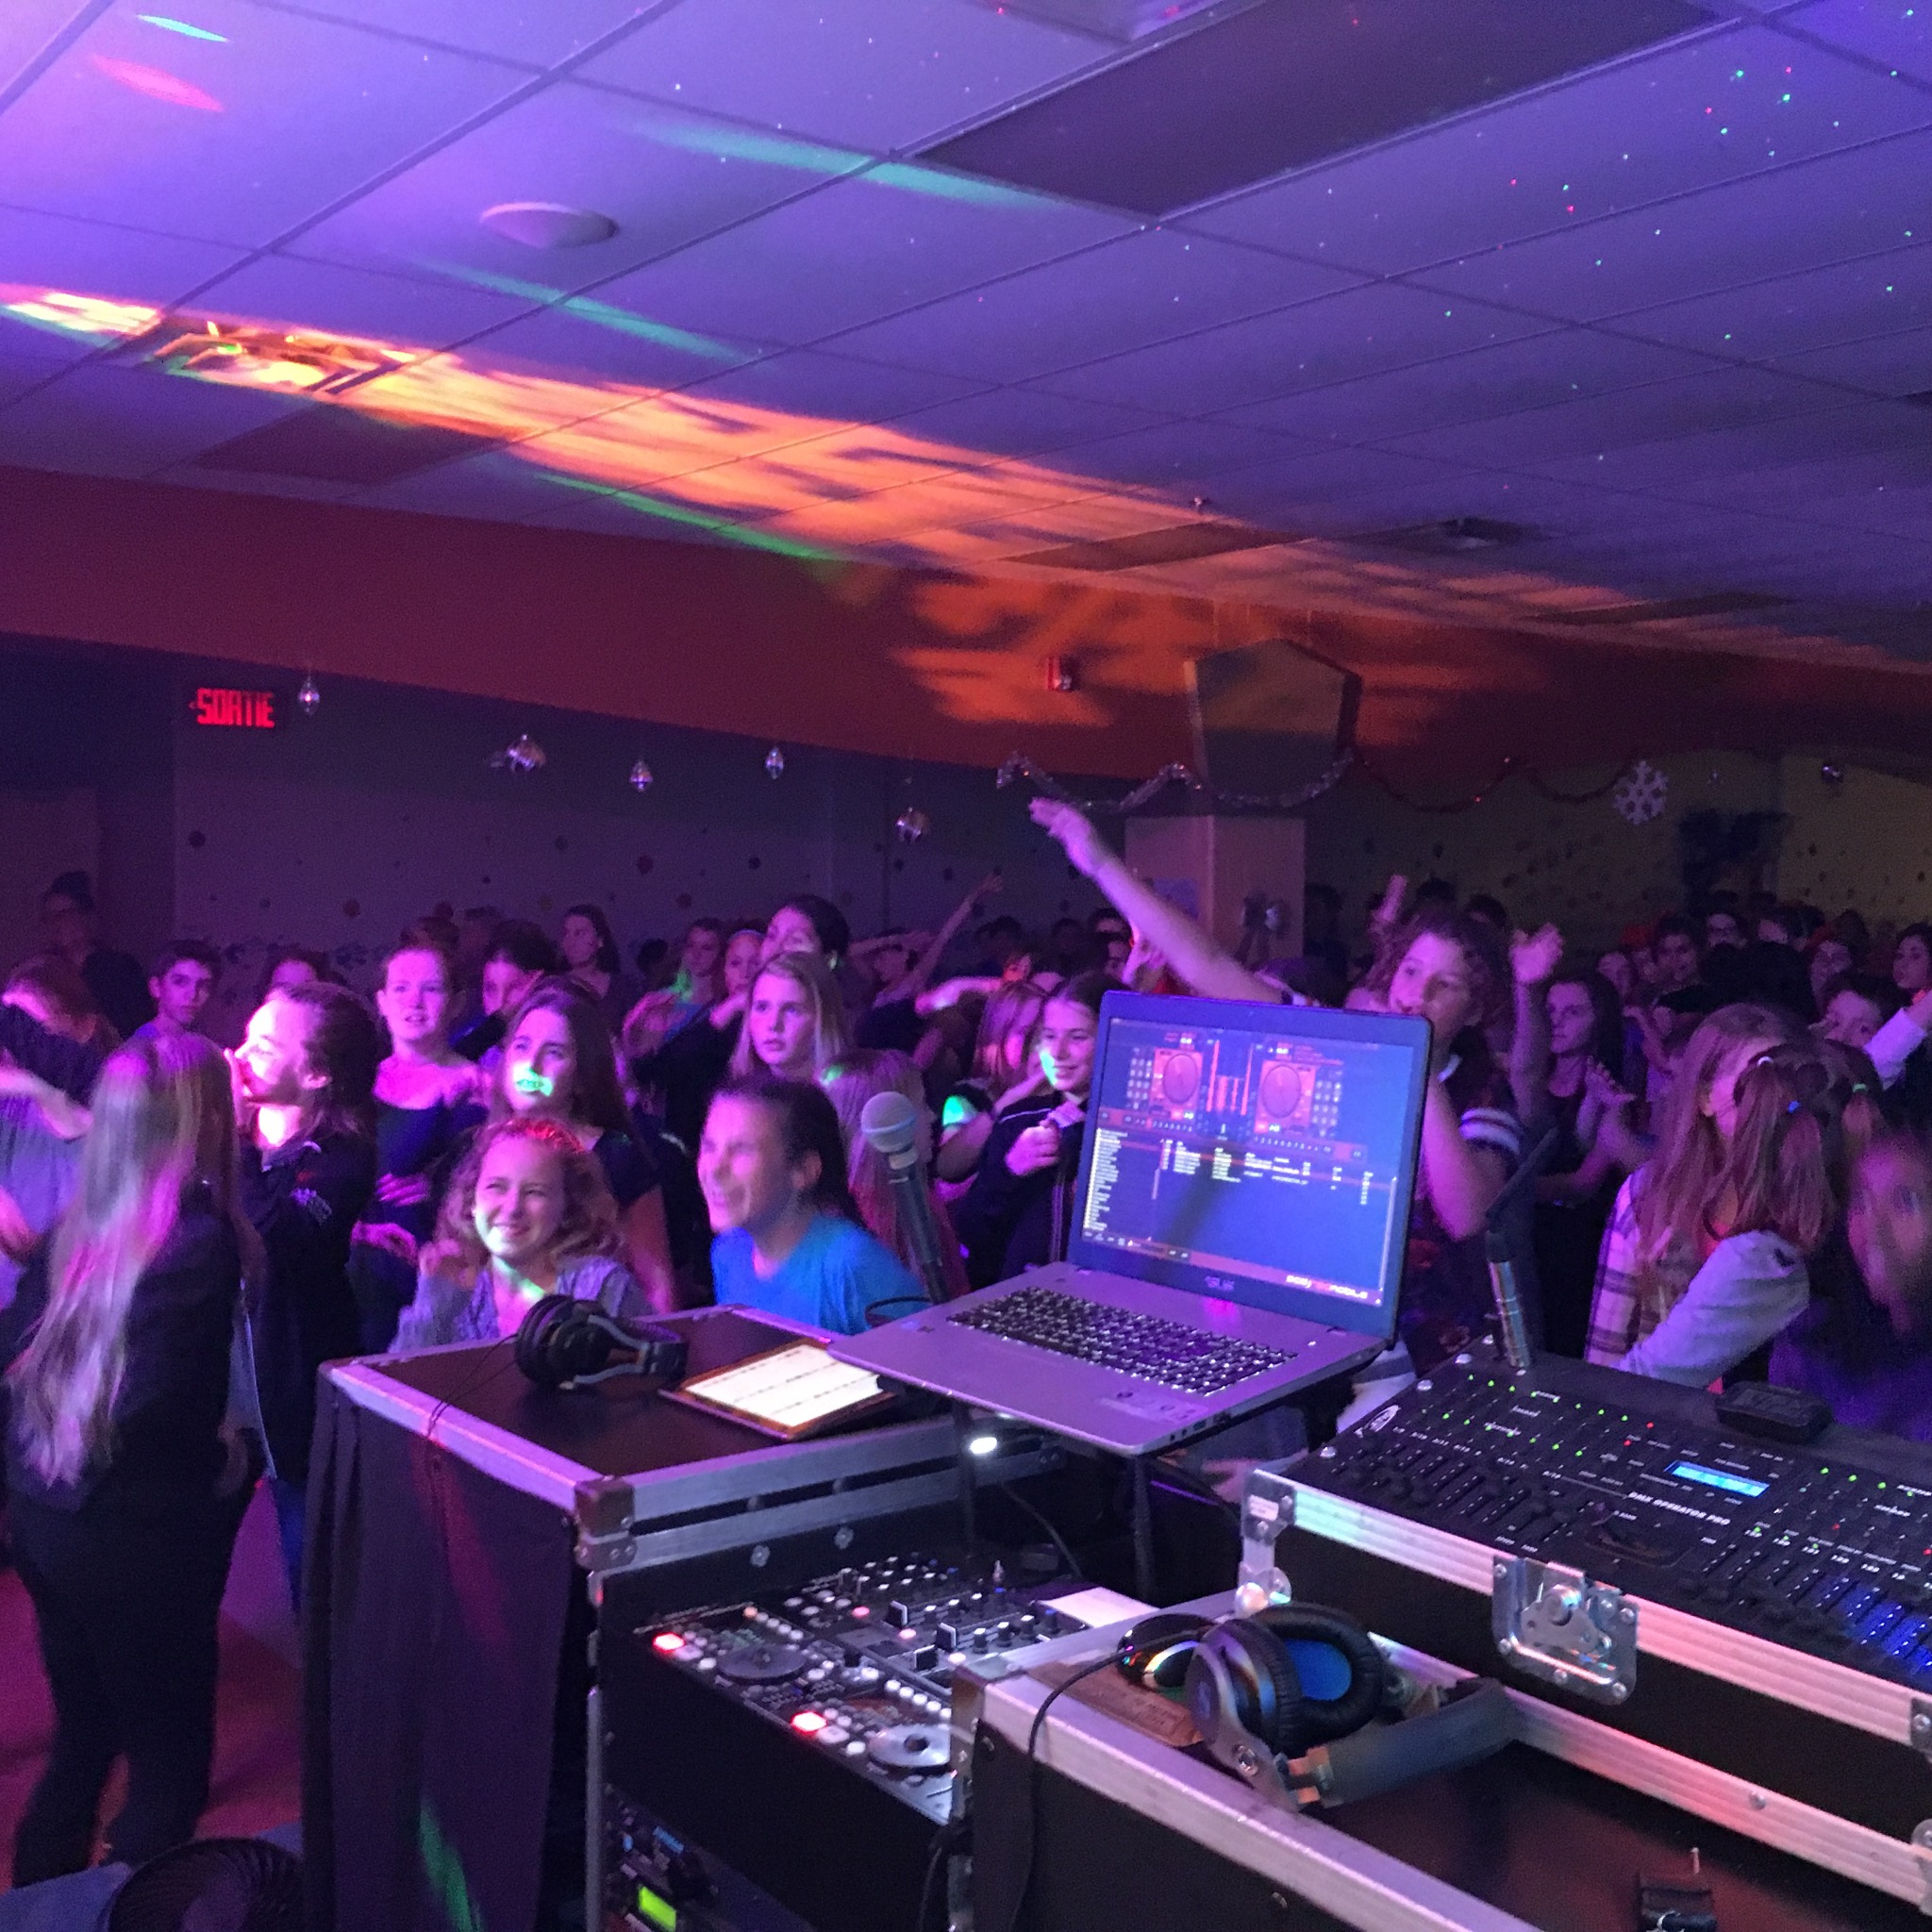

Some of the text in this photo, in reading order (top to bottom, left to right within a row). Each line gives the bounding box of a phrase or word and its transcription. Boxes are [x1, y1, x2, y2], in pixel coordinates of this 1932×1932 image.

[197, 688, 275, 728] SORTIE
[1627, 1491, 1731, 1526] DMX OPERATOR PRO
